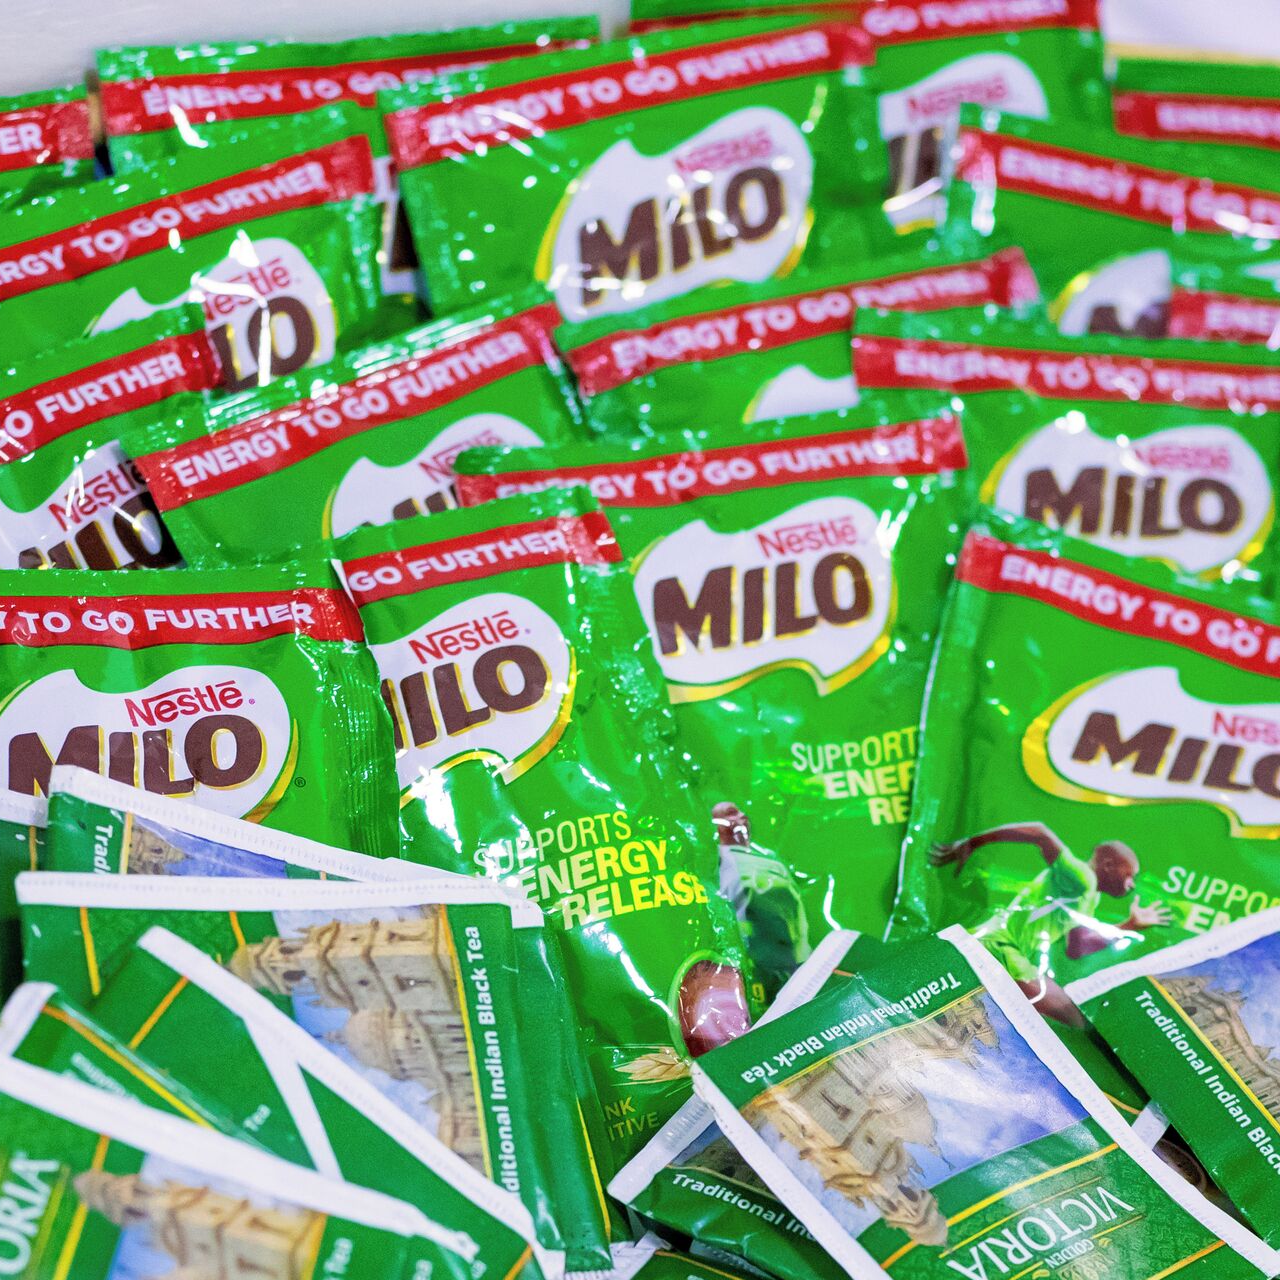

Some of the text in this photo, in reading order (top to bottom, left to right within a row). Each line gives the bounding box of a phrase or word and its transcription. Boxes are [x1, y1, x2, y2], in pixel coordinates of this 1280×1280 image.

[572, 26, 831, 109] TO GO FURTHER
[73, 229, 125, 260] TO
[127, 205, 183, 240] GO
[578, 166, 788, 307] MILO
[40, 352, 187, 424] FURTHER
[173, 330, 529, 489] ENERGY TO GO FURTHER
[642, 434, 919, 496] TO GO FURTHER
[757, 515, 858, 560] Nestlé
[1023, 466, 1244, 540] MILO
[349, 528, 568, 592] GO FURTHER
[22, 611, 72, 635] TO
[81, 609, 134, 635] GO
[146, 602, 315, 632] FURTHER
[409, 610, 519, 664] Nestlé
[652, 550, 874, 658] MILO
[1000, 553, 1145, 621] ENERGY
[1150, 602, 1201, 635] TO
[1207, 618, 1259, 657] GO
[124, 678, 244, 729] Nestlé
[8, 713, 263, 800] MILO
[519, 839, 669, 911] ENERGY
[559, 873, 709, 931] RELEASE
[465, 925, 509, 1101] Indian Black Tea
[740, 971, 963, 1085] Traditional Indian Black Tea
[1135, 990, 1214, 1077] Traditional
[1203, 1074, 1253, 1129] Indian
[671, 1172, 785, 1226] Traditional
[1045, 1235, 1096, 1267] GOLDEN
